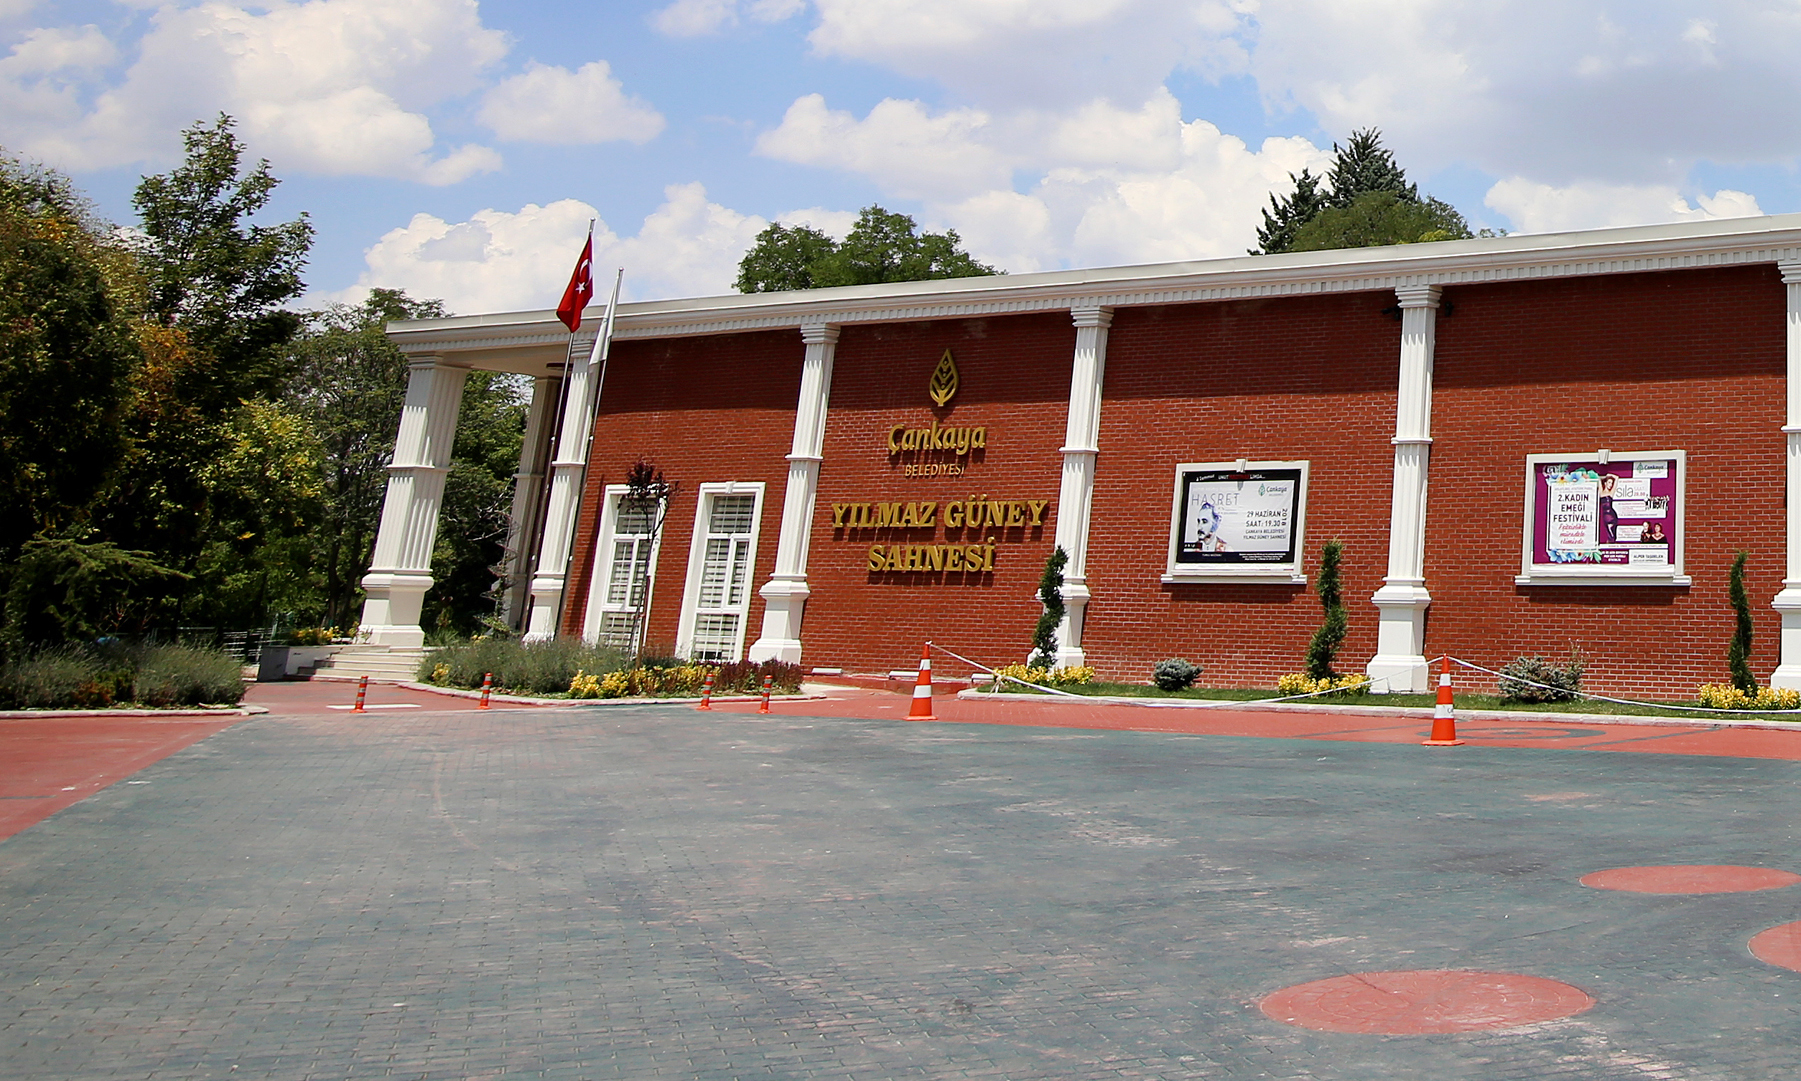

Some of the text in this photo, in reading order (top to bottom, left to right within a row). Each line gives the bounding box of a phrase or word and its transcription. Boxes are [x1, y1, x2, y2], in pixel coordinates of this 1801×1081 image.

[887, 420, 986, 455] Çankaya
[904, 461, 965, 477] BELEDİYESİ
[1191, 493, 1240, 506] HASRET
[831, 494, 1049, 528] YILMAZ GÜNEY
[1255, 509, 1281, 517] HAZİRAN
[1561, 502, 1585, 512] EMEĞİ
[1553, 512, 1593, 522] FESTİVALİ
[866, 536, 996, 572] SAHNESİ
